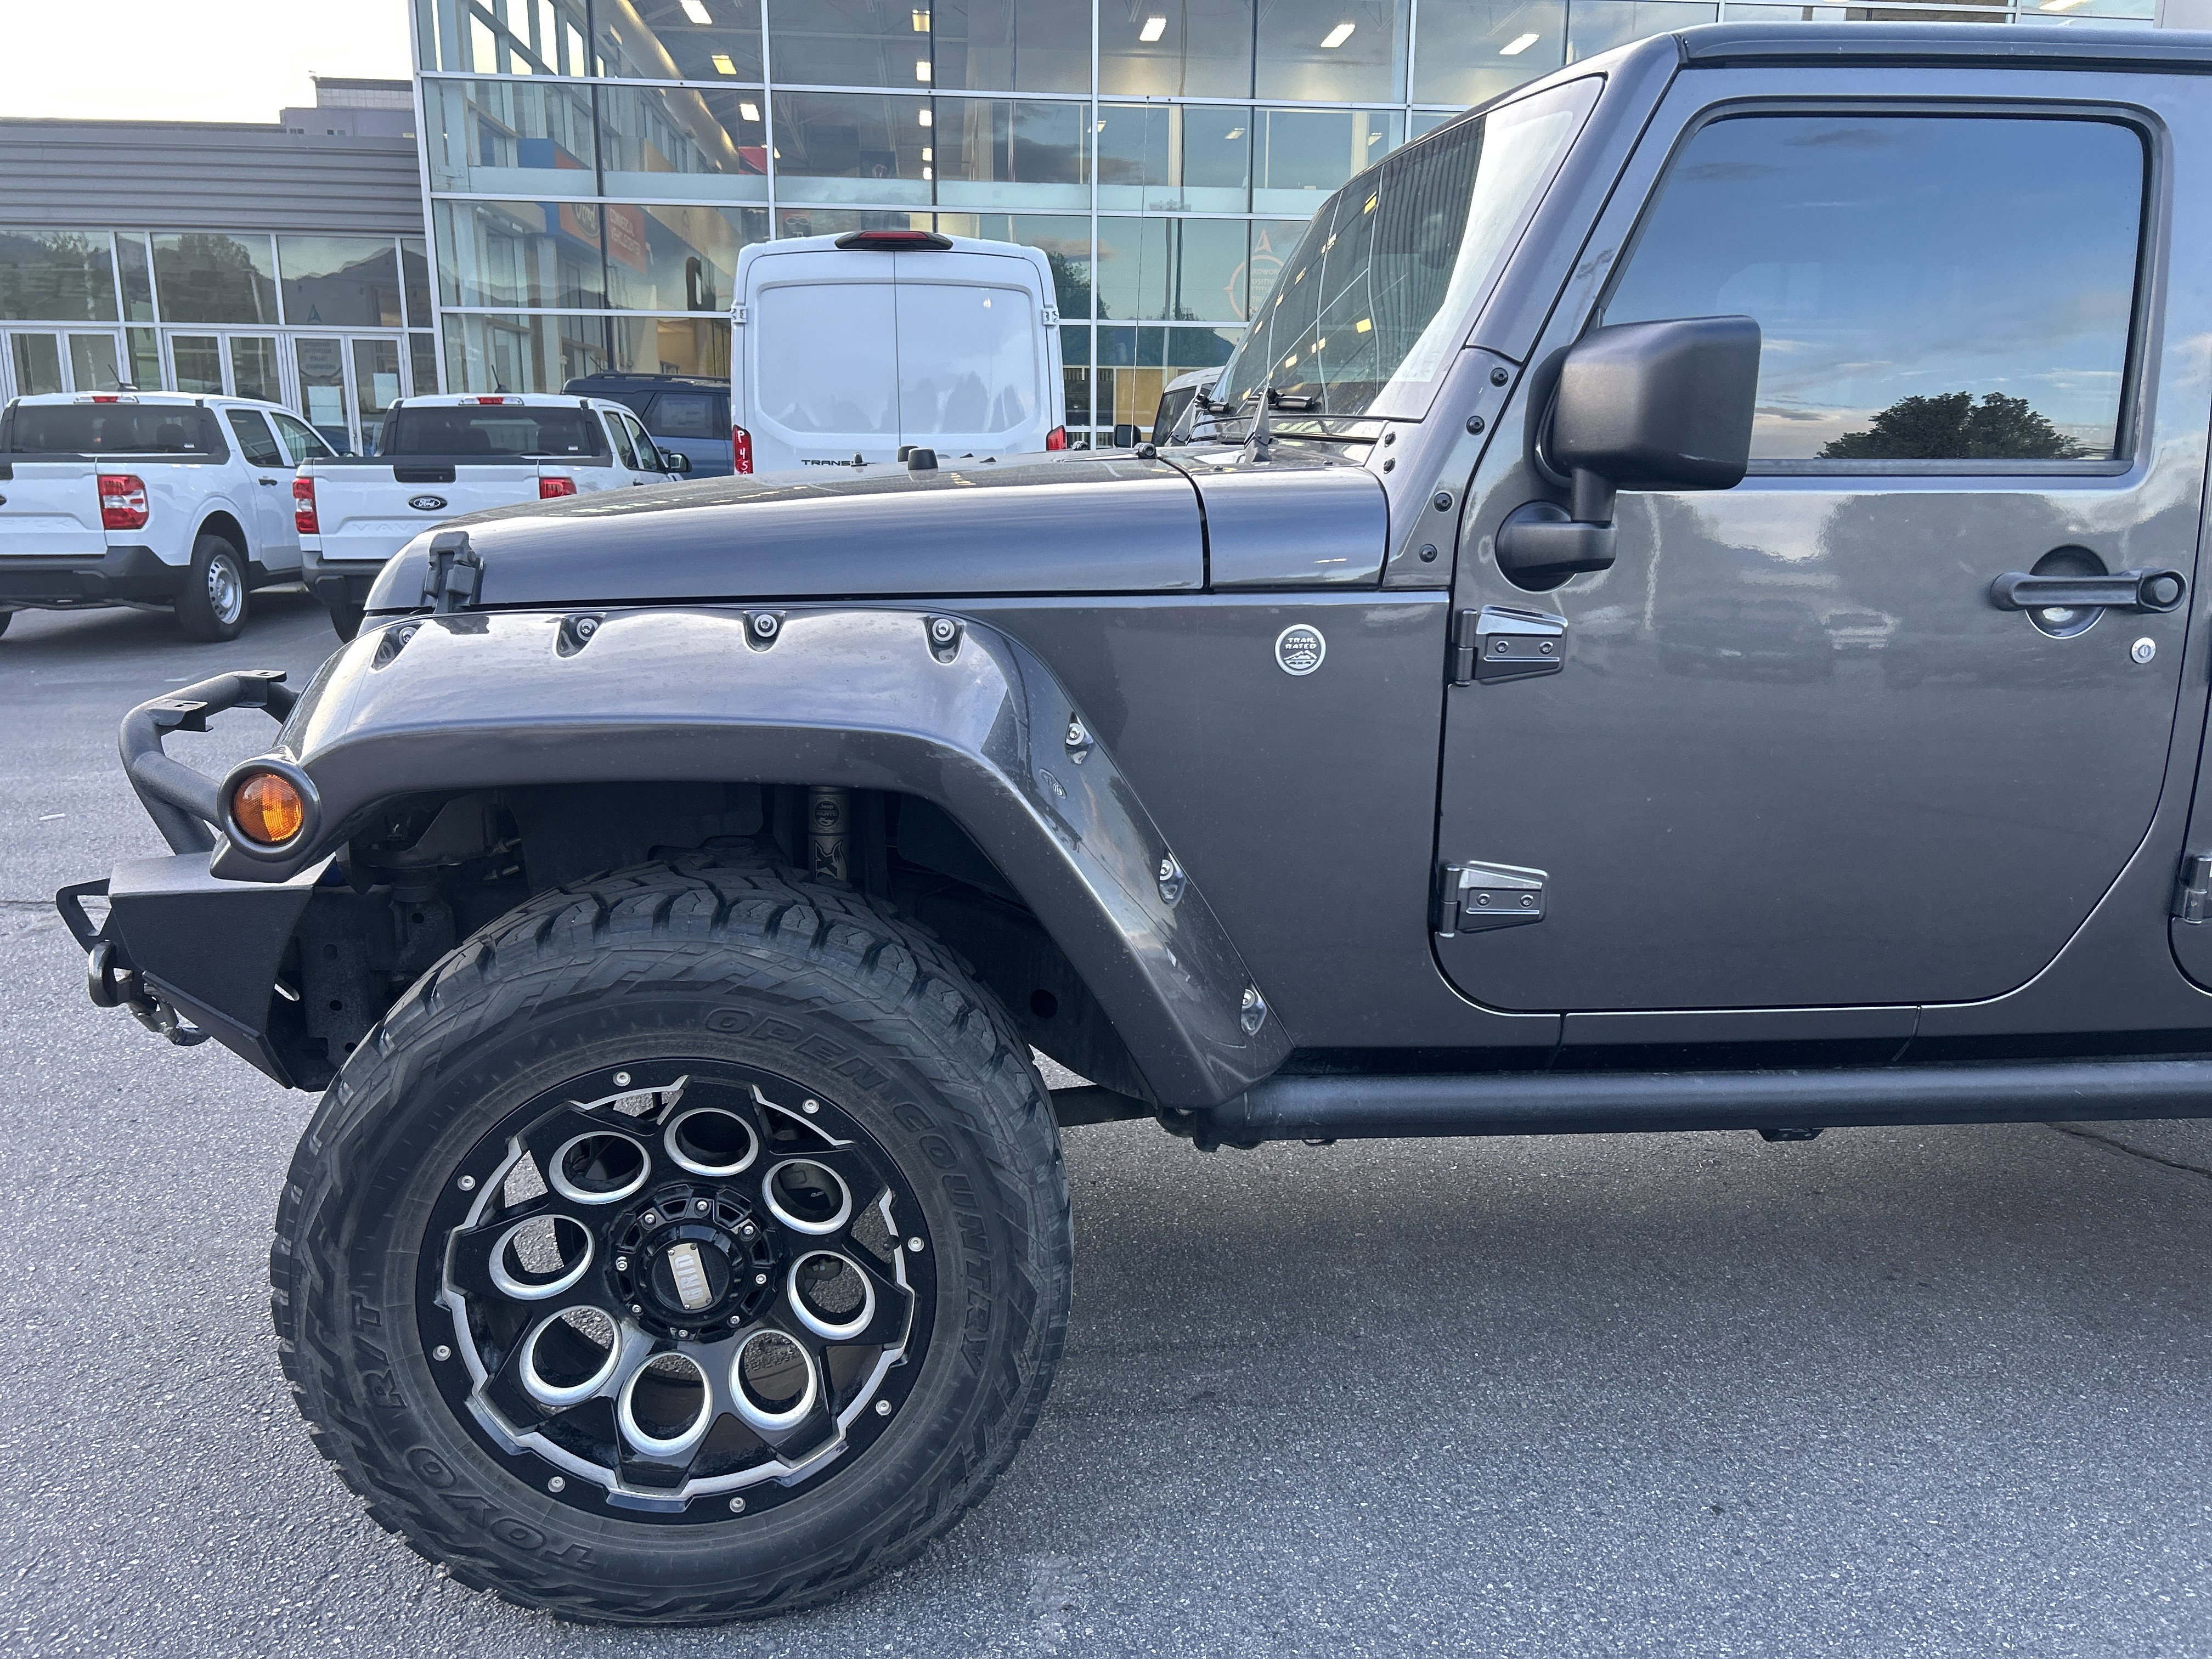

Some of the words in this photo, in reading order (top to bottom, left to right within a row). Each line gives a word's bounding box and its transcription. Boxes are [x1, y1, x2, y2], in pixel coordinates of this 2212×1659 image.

[418, 498, 436, 507] Ford
[704, 1008, 889, 1091] OPEN
[891, 1101, 994, 1378] COUNTRY
[674, 1254, 703, 1301] GRID
[351, 1297, 407, 1410] R/T
[404, 1446, 598, 1576] TOYO
